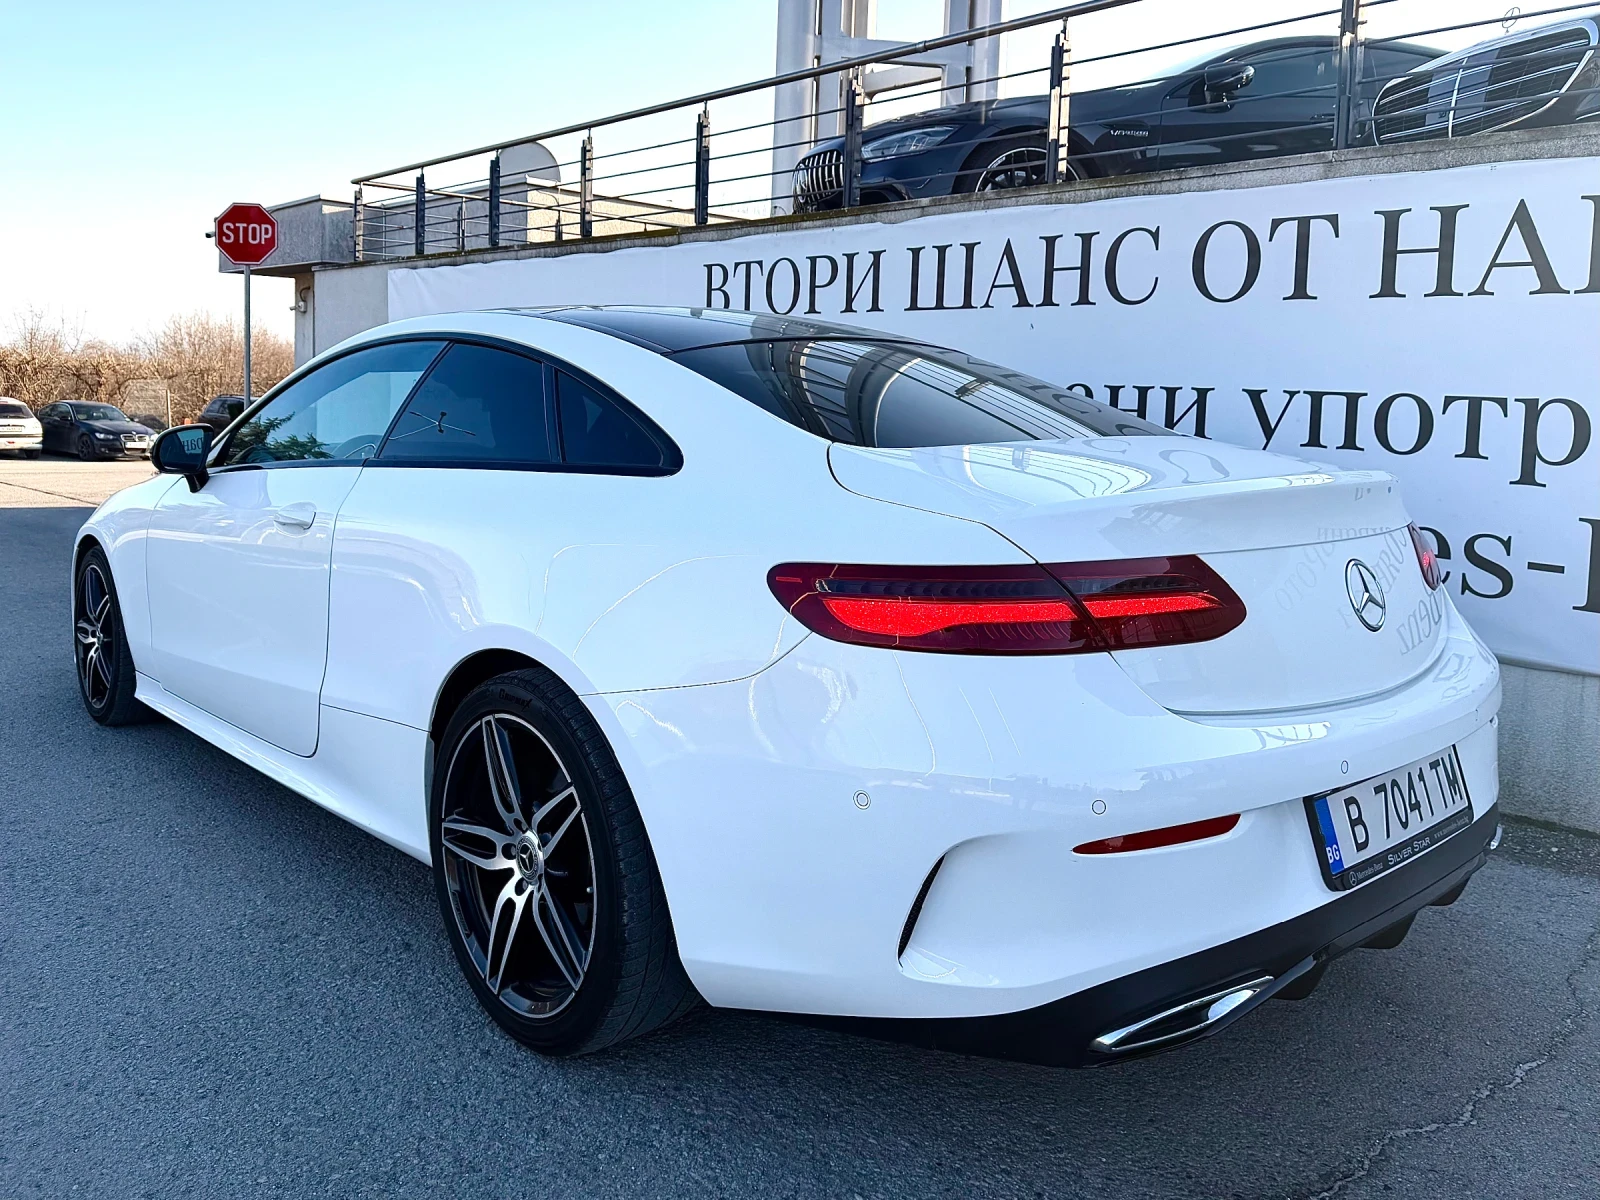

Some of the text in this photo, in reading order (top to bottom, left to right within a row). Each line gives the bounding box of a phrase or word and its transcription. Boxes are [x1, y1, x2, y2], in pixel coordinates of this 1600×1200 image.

[222, 222, 272, 244] STOP
[703, 194, 1600, 315] ВТОРИ ШАНС ОТ НА
[1242, 387, 1591, 487] употр
[1344, 796, 1370, 853] B
[1373, 766, 1434, 840] 7041
[1428, 753, 1464, 810] TM
[1326, 844, 1341, 863] BG
[1387, 846, 1413, 866] SILVER
[1413, 836, 1432, 852] STAR
